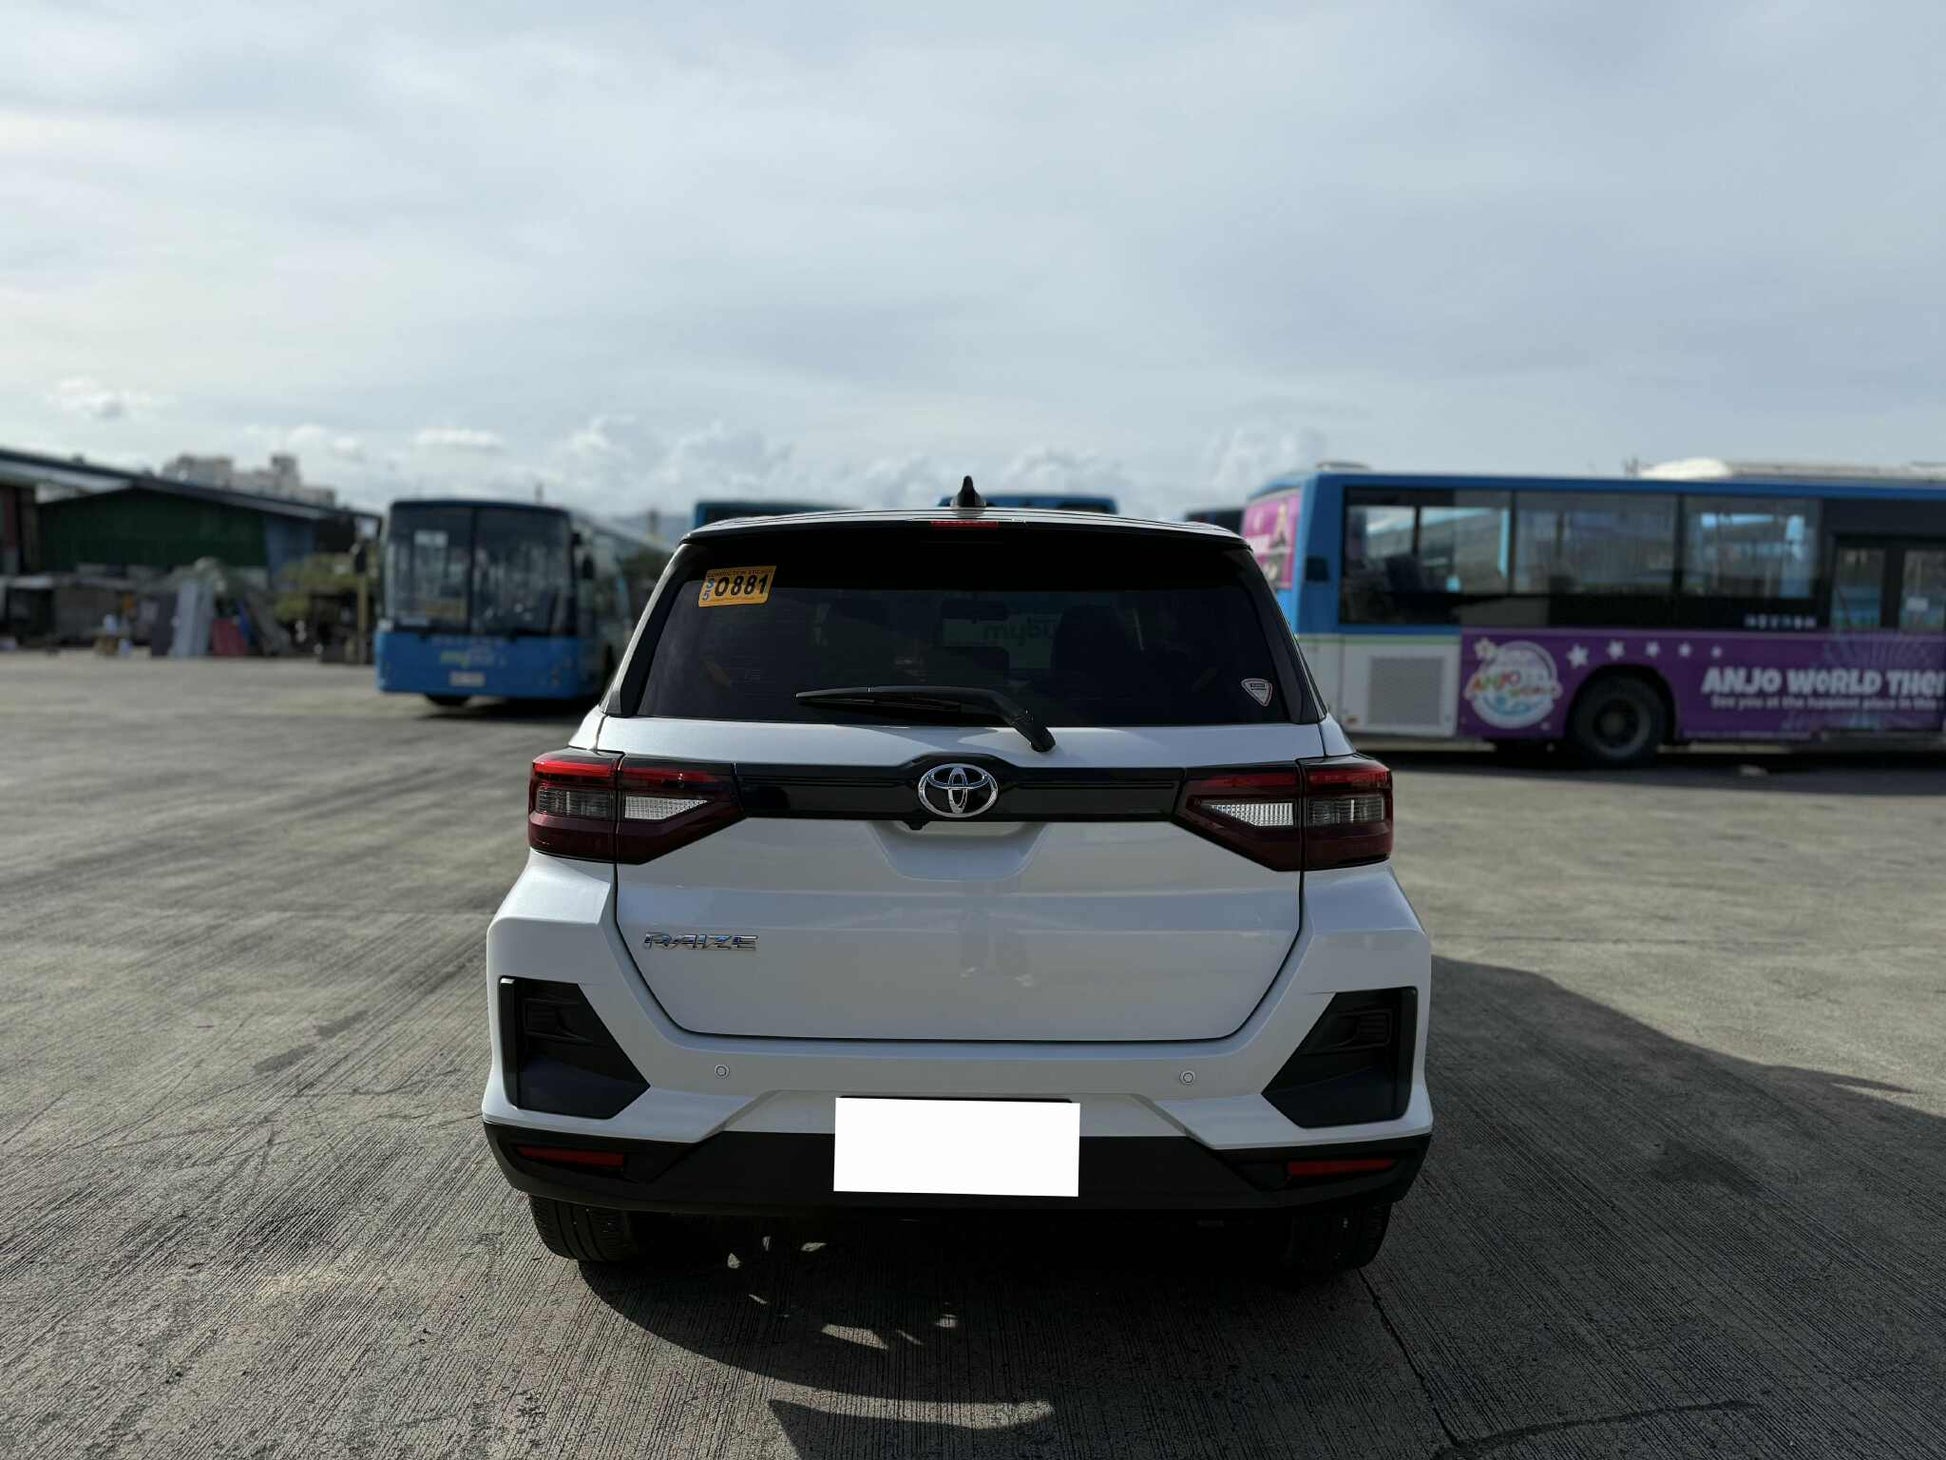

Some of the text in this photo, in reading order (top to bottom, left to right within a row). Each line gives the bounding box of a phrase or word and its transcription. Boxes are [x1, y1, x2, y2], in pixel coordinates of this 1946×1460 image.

[984, 616, 1056, 646] mybu
[1701, 666, 1783, 694] ANJO
[1786, 668, 1882, 696] WORLD
[643, 931, 759, 951] RAIZE
